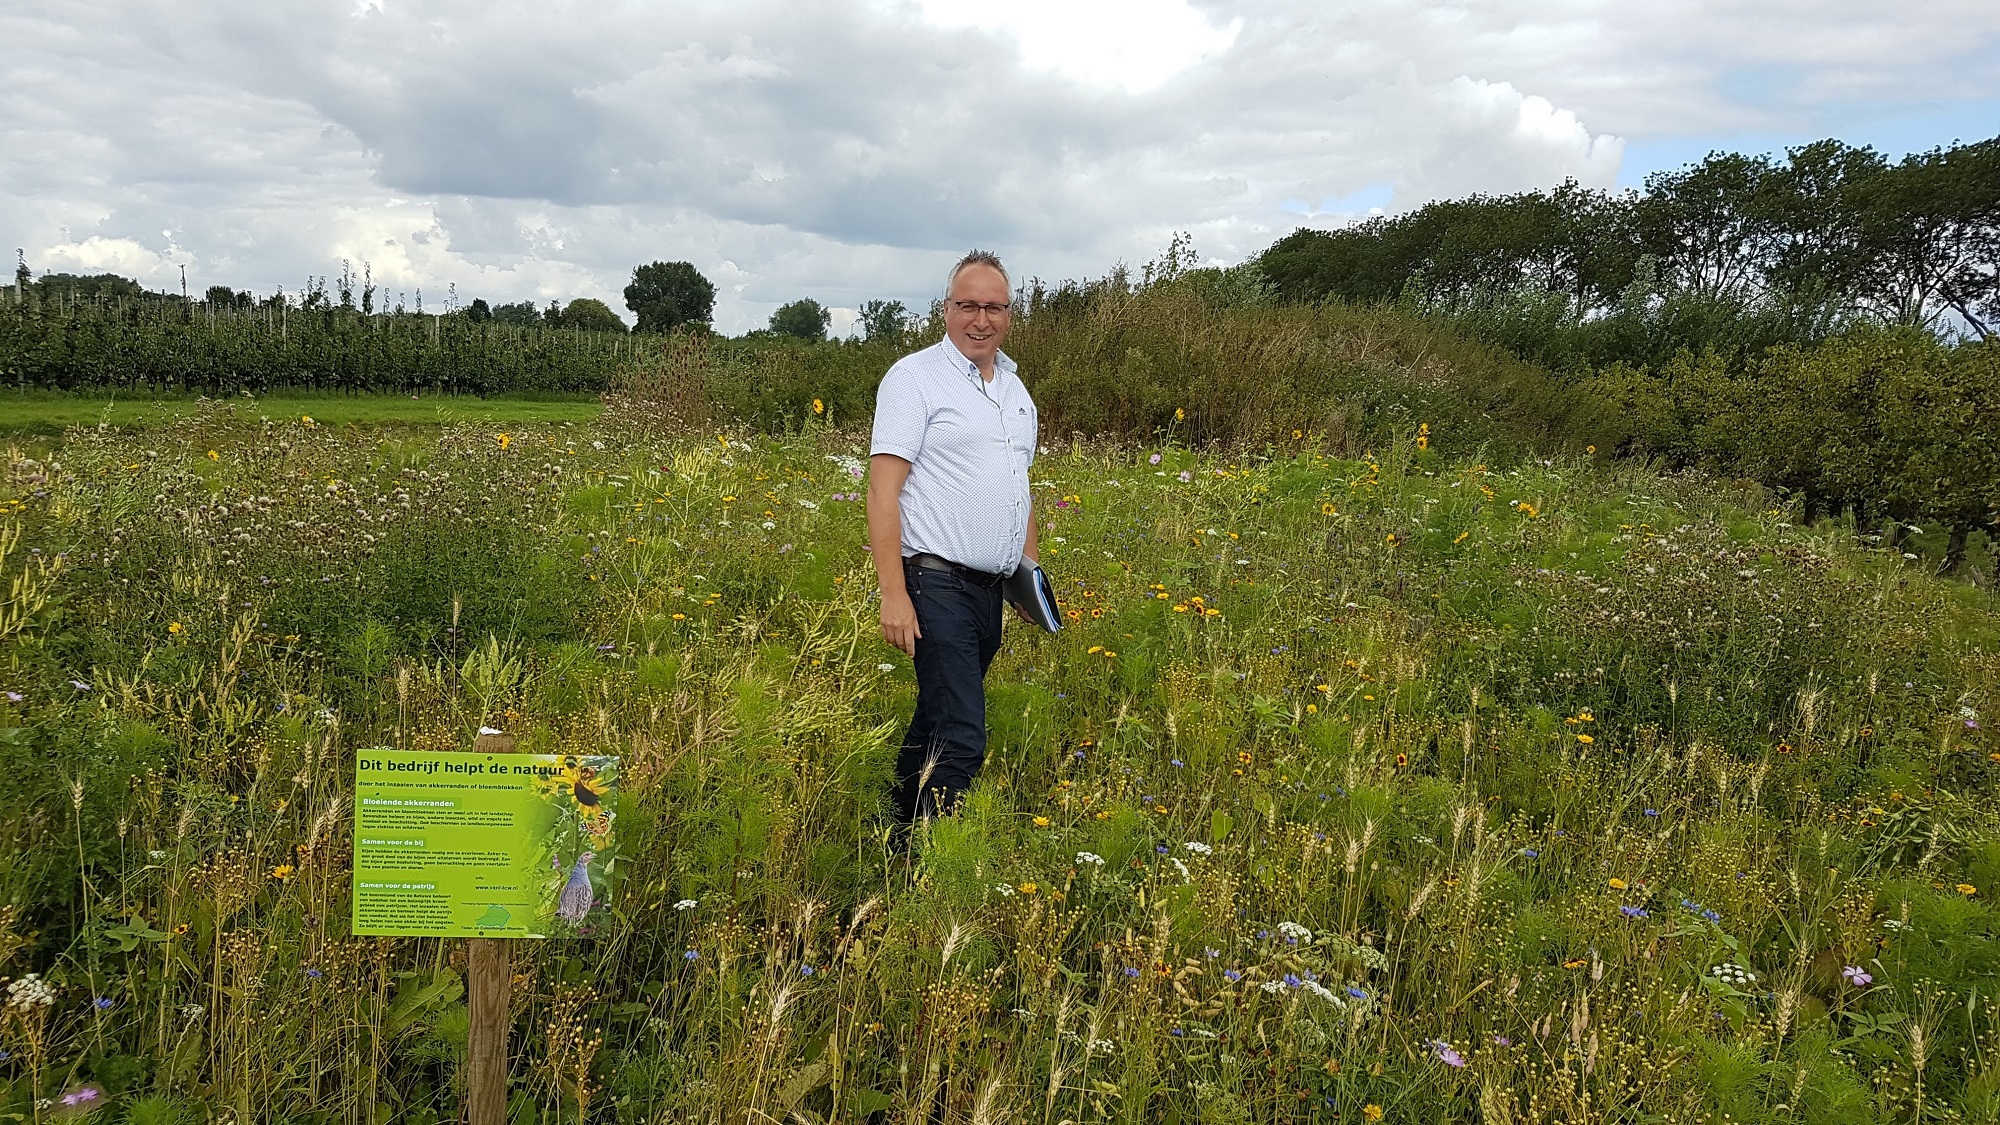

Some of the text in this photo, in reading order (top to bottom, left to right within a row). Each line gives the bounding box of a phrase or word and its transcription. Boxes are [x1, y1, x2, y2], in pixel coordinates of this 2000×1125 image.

[360, 759, 564, 775] Dit bedrijf helpt de natuur
